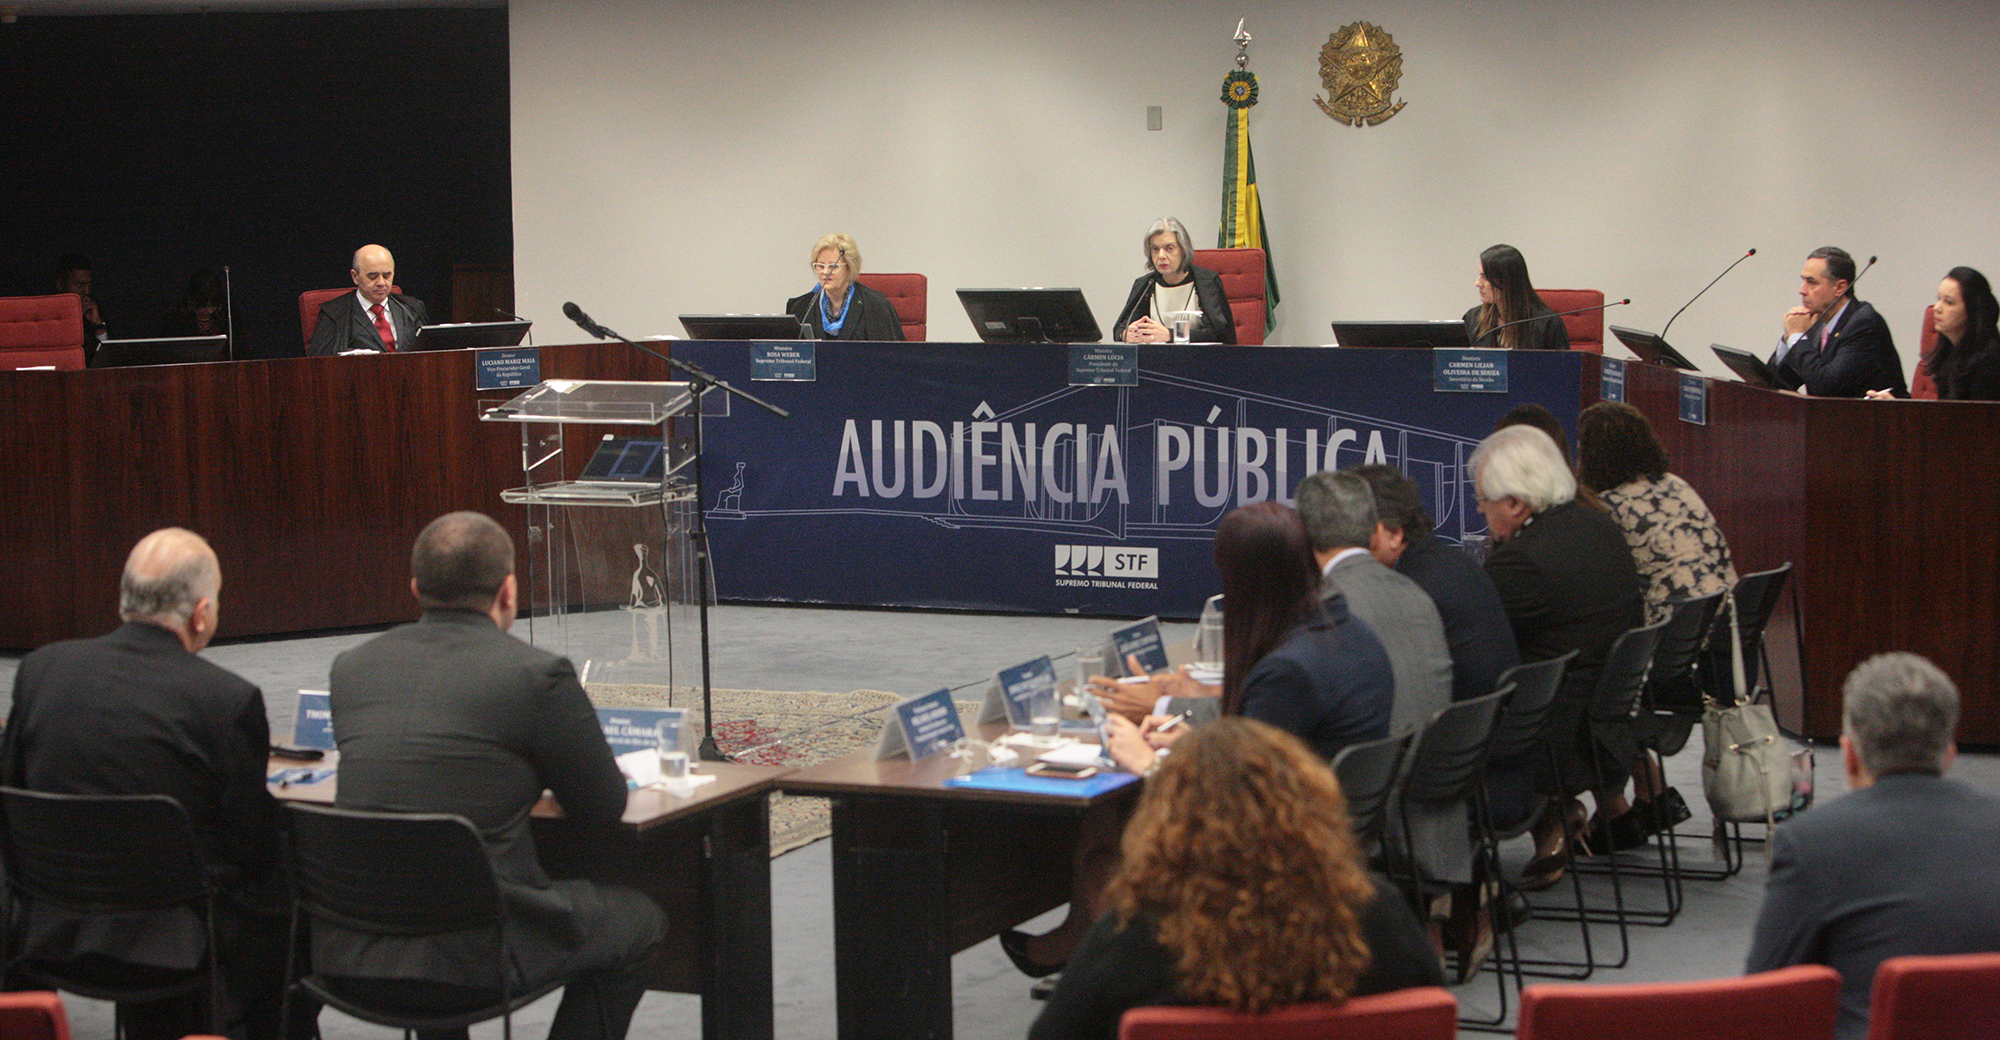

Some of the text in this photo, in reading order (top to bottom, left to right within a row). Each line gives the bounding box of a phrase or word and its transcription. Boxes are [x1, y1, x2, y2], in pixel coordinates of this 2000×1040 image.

[832, 400, 1130, 505] AUDIÊNCIA
[1115, 553, 1148, 571] STF
[1055, 579, 1158, 590] SUPREMO TRIBUNAL FEDERAL
